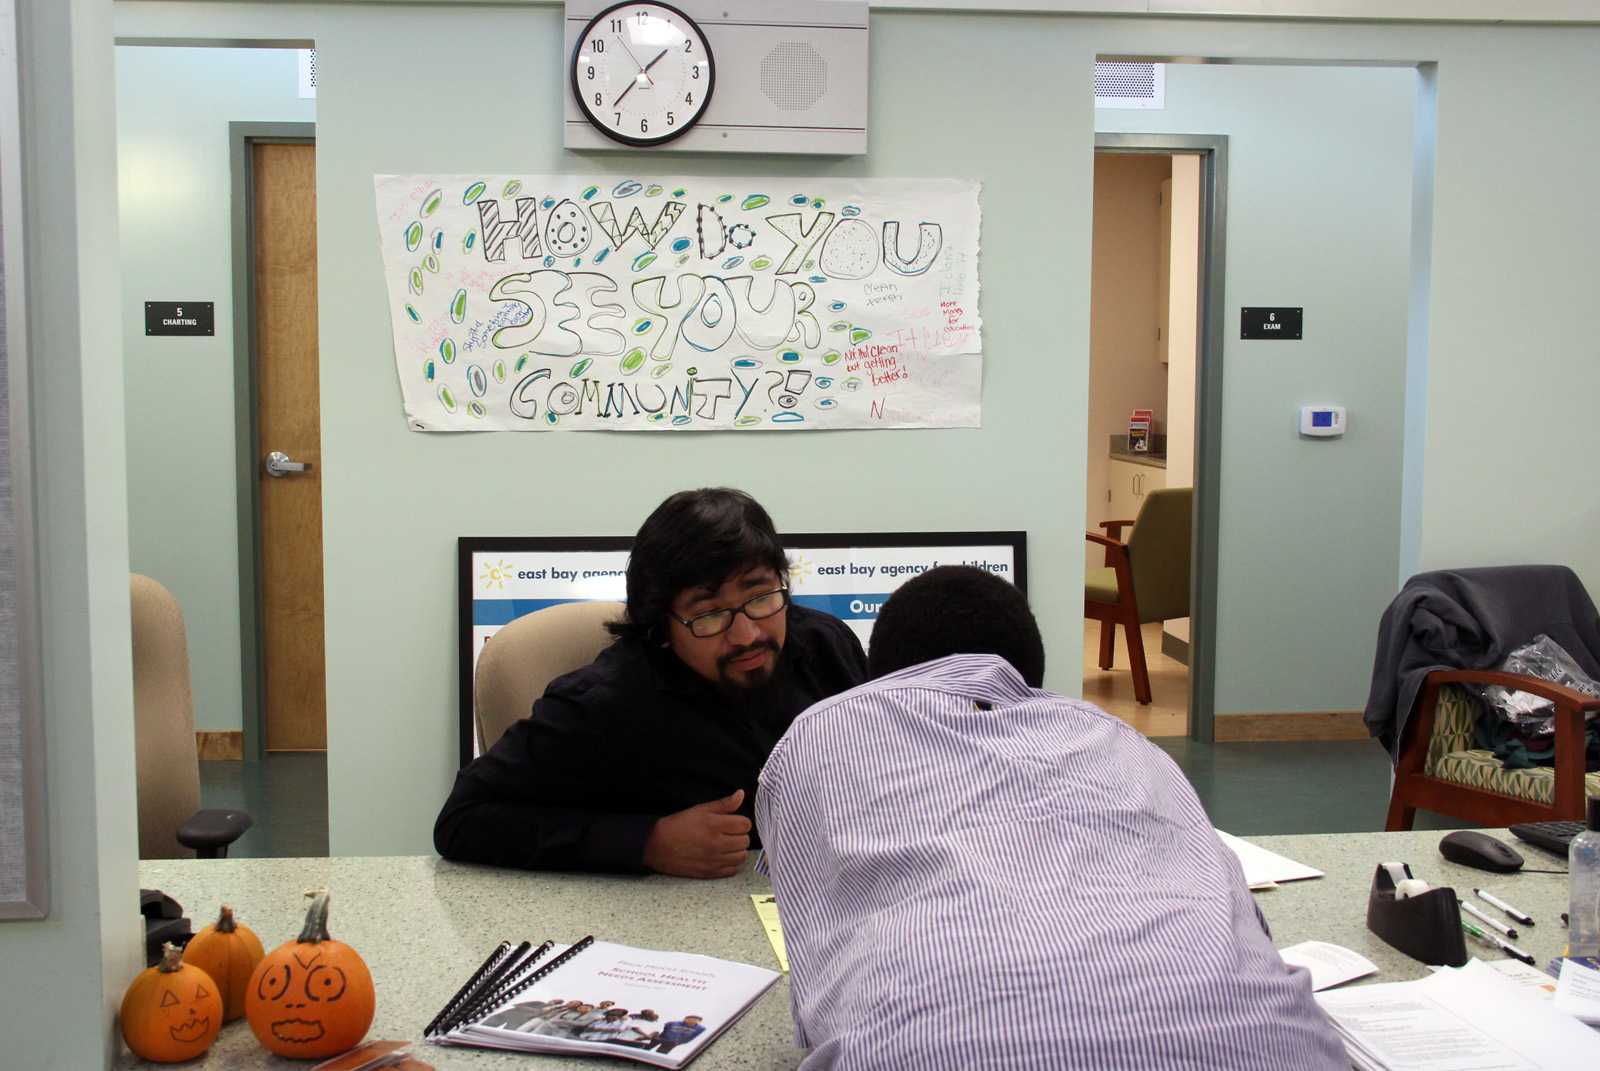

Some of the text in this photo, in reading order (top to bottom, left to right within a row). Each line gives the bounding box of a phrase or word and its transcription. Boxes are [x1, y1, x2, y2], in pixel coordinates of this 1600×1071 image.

[636, 11, 649, 26] 12
[610, 19, 622, 33] 11
[591, 39, 604, 53] 10
[685, 39, 692, 53] 2
[588, 66, 595, 80] 9
[692, 65, 699, 79] 3
[595, 92, 602, 106] 8
[685, 92, 693, 105] 4
[614, 112, 621, 126] 7
[667, 112, 674, 125] 5
[640, 119, 648, 133] 6
[477, 197, 687, 262] HOW
[765, 211, 943, 280] YOU
[176, 307, 183, 317] 5
[489, 269, 821, 361] SEE YOUR
[1269, 312, 1276, 322] 6
[162, 318, 197, 326] CHARTING
[864, 356, 897, 376] getting
[517, 566, 627, 583] east bay aenc
[817, 562, 846, 575] east
[850, 562, 876, 578] bay
[880, 564, 929, 578] agency
[850, 599, 883, 614] Our
